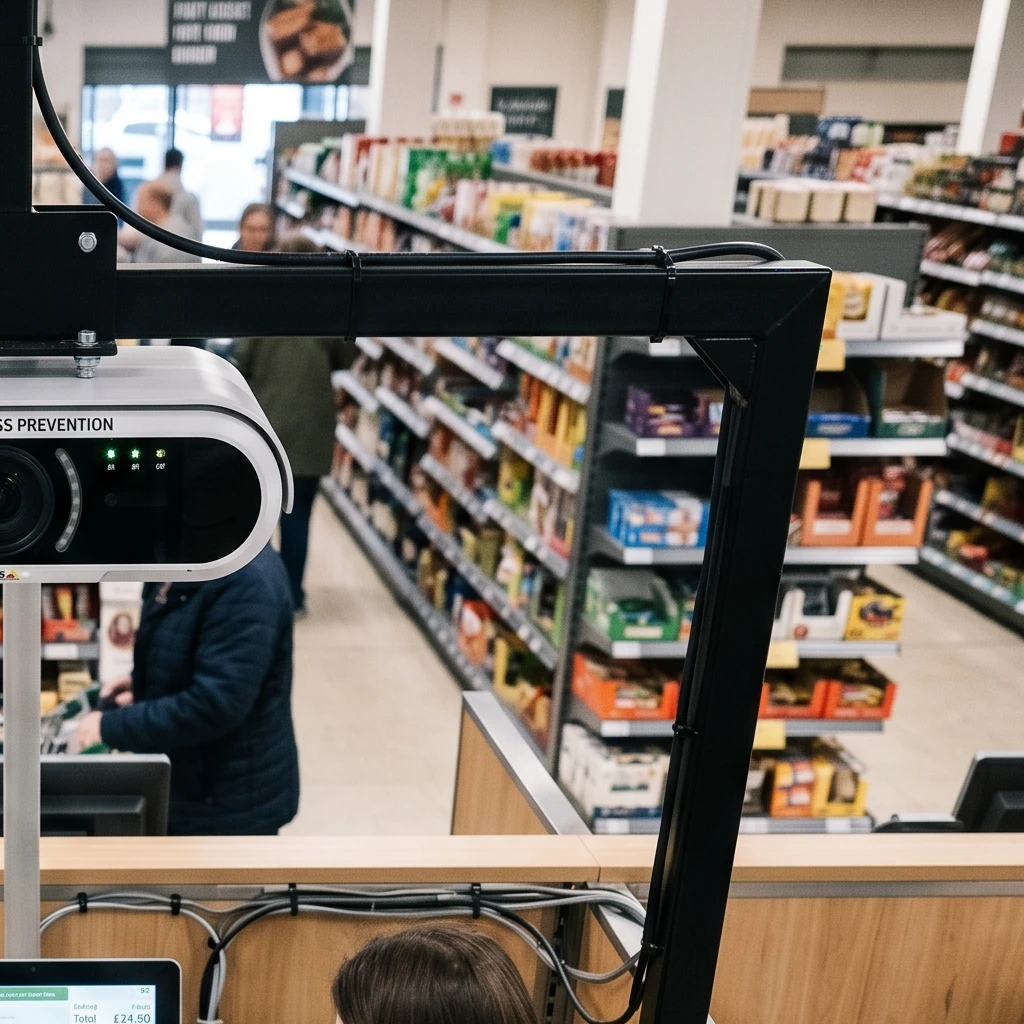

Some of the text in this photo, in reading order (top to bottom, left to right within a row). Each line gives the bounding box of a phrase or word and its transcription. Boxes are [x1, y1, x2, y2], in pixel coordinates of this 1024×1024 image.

[17, 417, 114, 432] PREVENTION
[73, 1013, 151, 1024] Total £24.50
